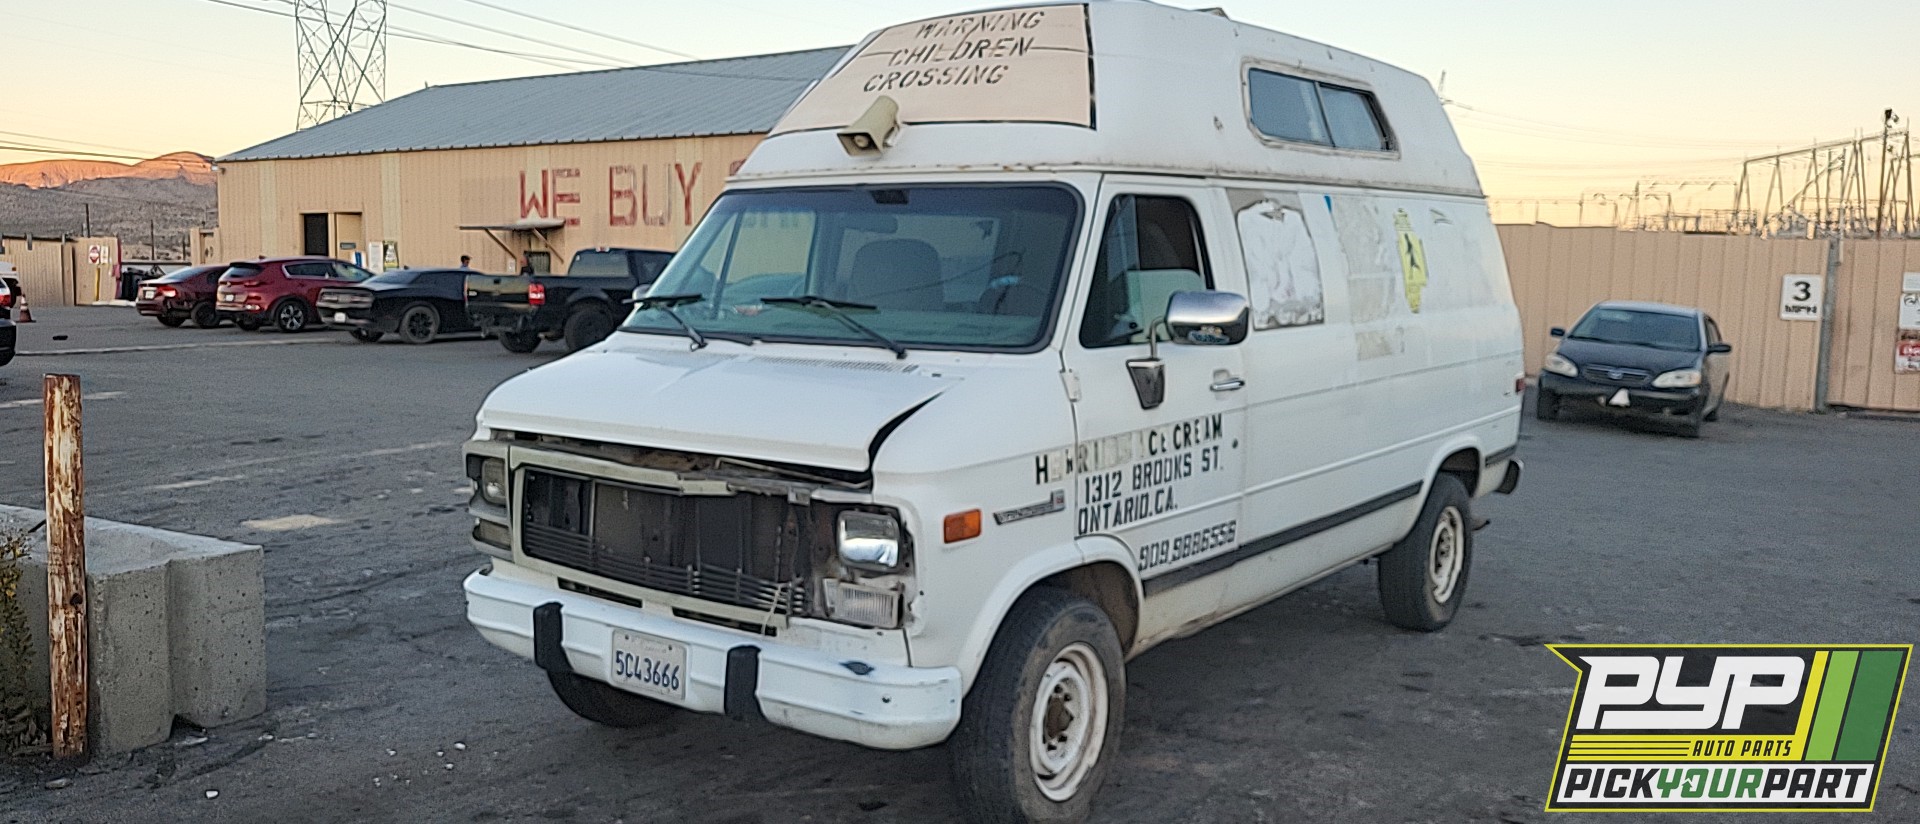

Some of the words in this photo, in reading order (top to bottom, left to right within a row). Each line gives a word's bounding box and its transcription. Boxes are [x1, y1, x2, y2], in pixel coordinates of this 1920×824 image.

[915, 10, 1046, 39] WARNING
[888, 36, 1035, 67] CHILDREN
[862, 64, 1010, 93] CROSSING
[519, 167, 581, 226] WE
[608, 161, 702, 227] BUY
[1792, 281, 1811, 301] 3
[1085, 470, 1123, 505] 1312
[1132, 452, 1192, 490] BROOKS
[616, 650, 680, 690] 5C43666
